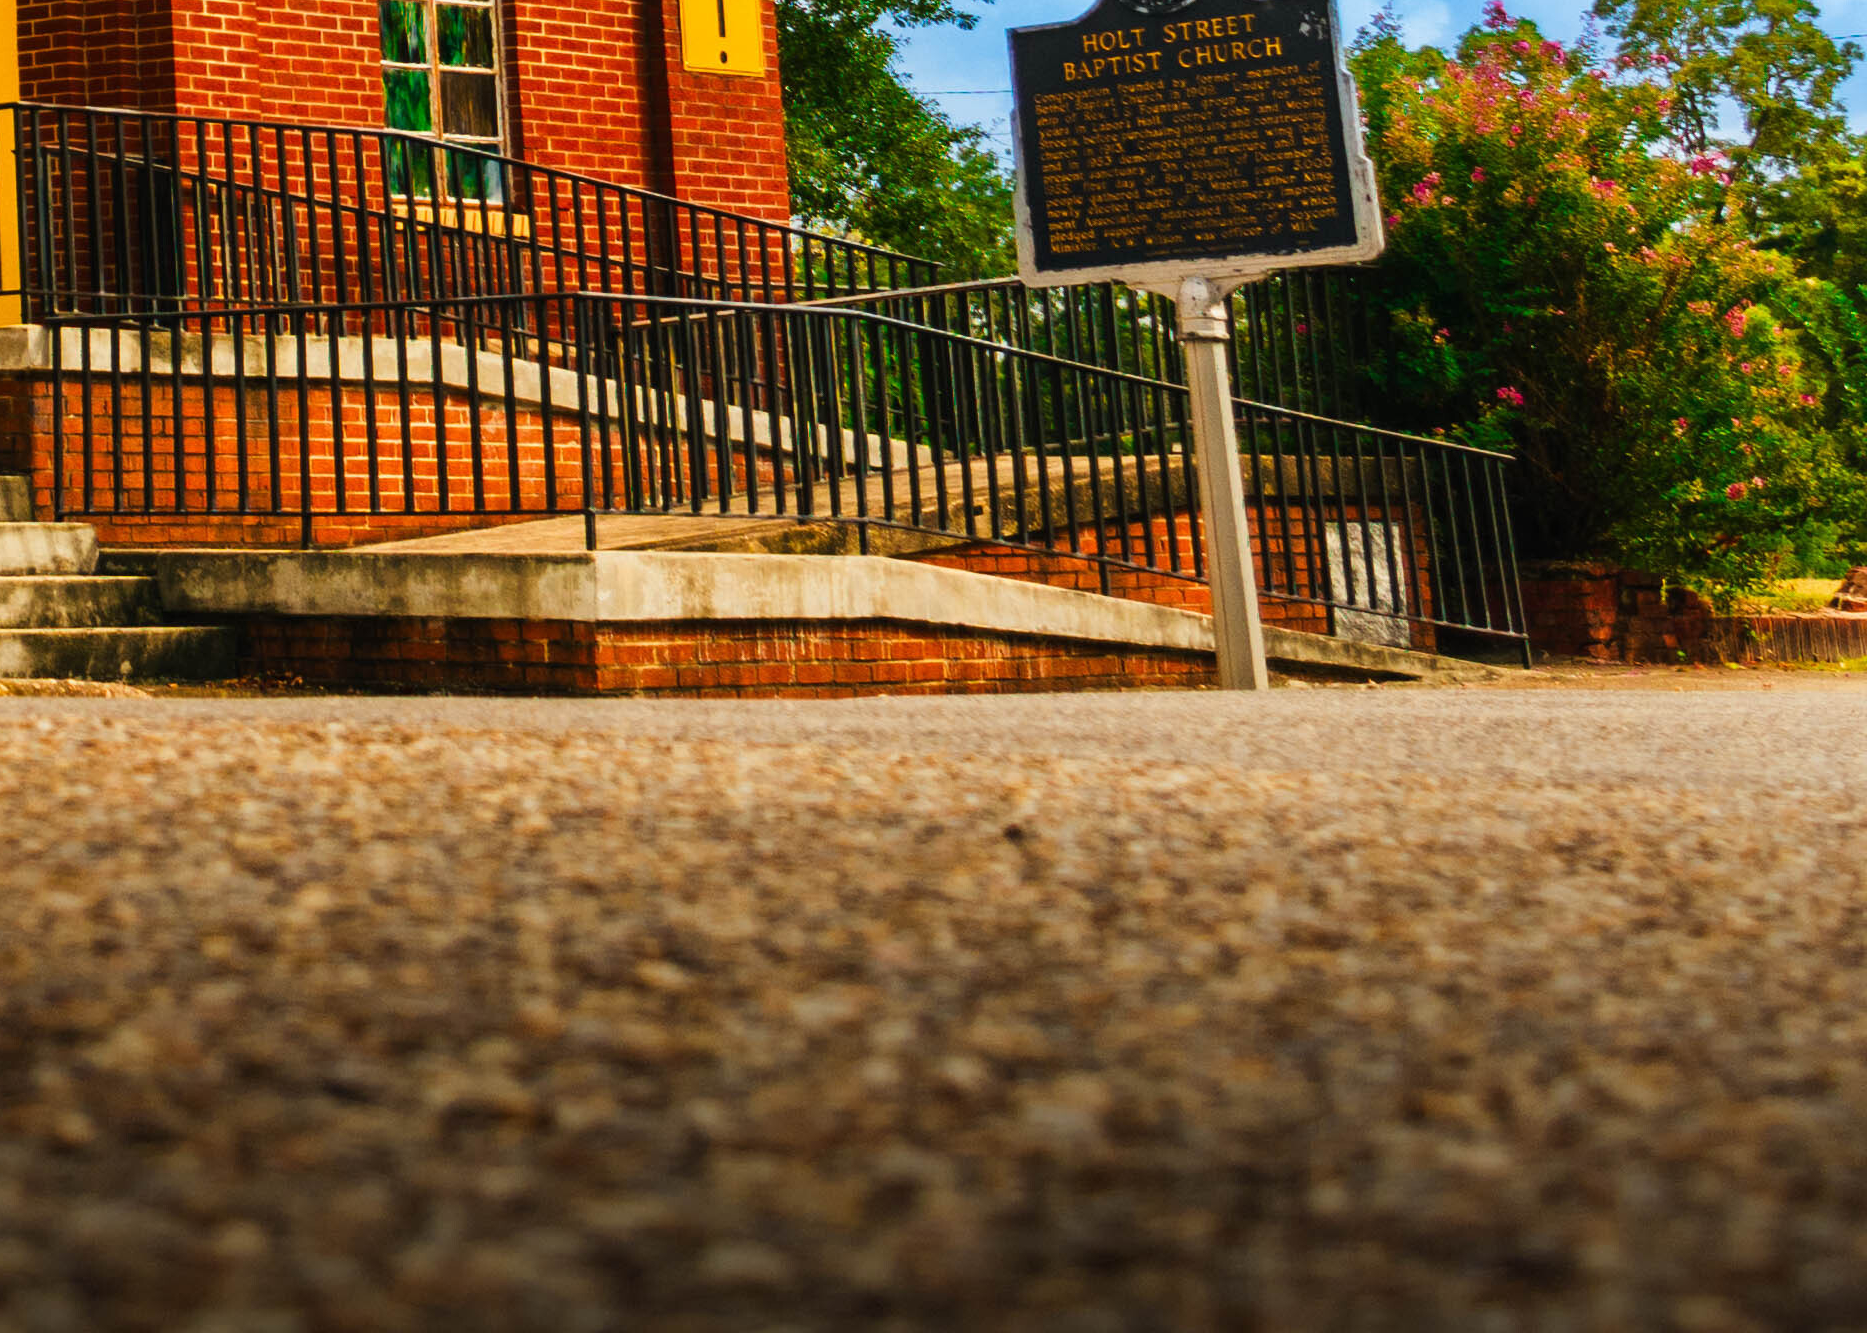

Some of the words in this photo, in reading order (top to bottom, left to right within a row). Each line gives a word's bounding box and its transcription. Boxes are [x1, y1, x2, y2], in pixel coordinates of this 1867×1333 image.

[1082, 27, 1146, 53] HOLT
[1163, 13, 1256, 43] STREET
[1063, 51, 1162, 81] BAPTIST
[1178, 36, 1283, 68] CHURCH
